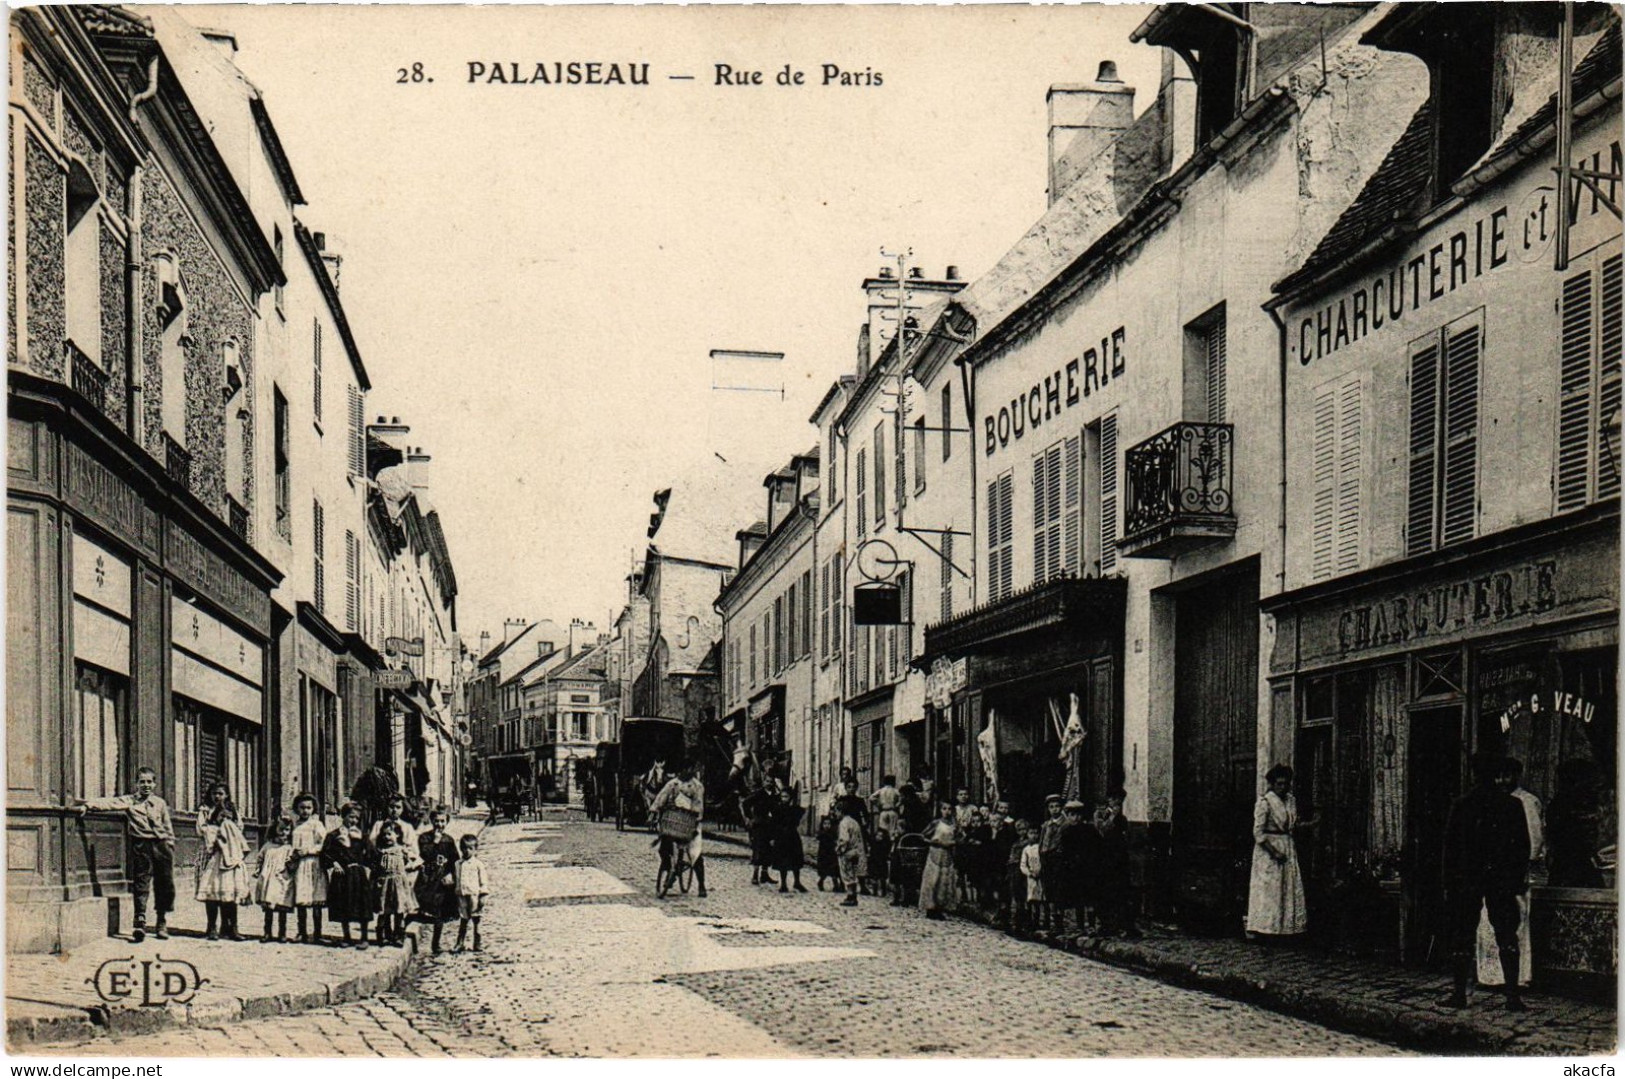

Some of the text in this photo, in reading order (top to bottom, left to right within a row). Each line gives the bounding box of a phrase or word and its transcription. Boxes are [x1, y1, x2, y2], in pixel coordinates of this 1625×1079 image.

[1300, 206, 1508, 366] CHARCUTERIE
[985, 325, 1125, 457] BOUCHERIE
[1339, 560, 1556, 651] CHARCUTERIE
[1554, 690, 1595, 723] VEAU
